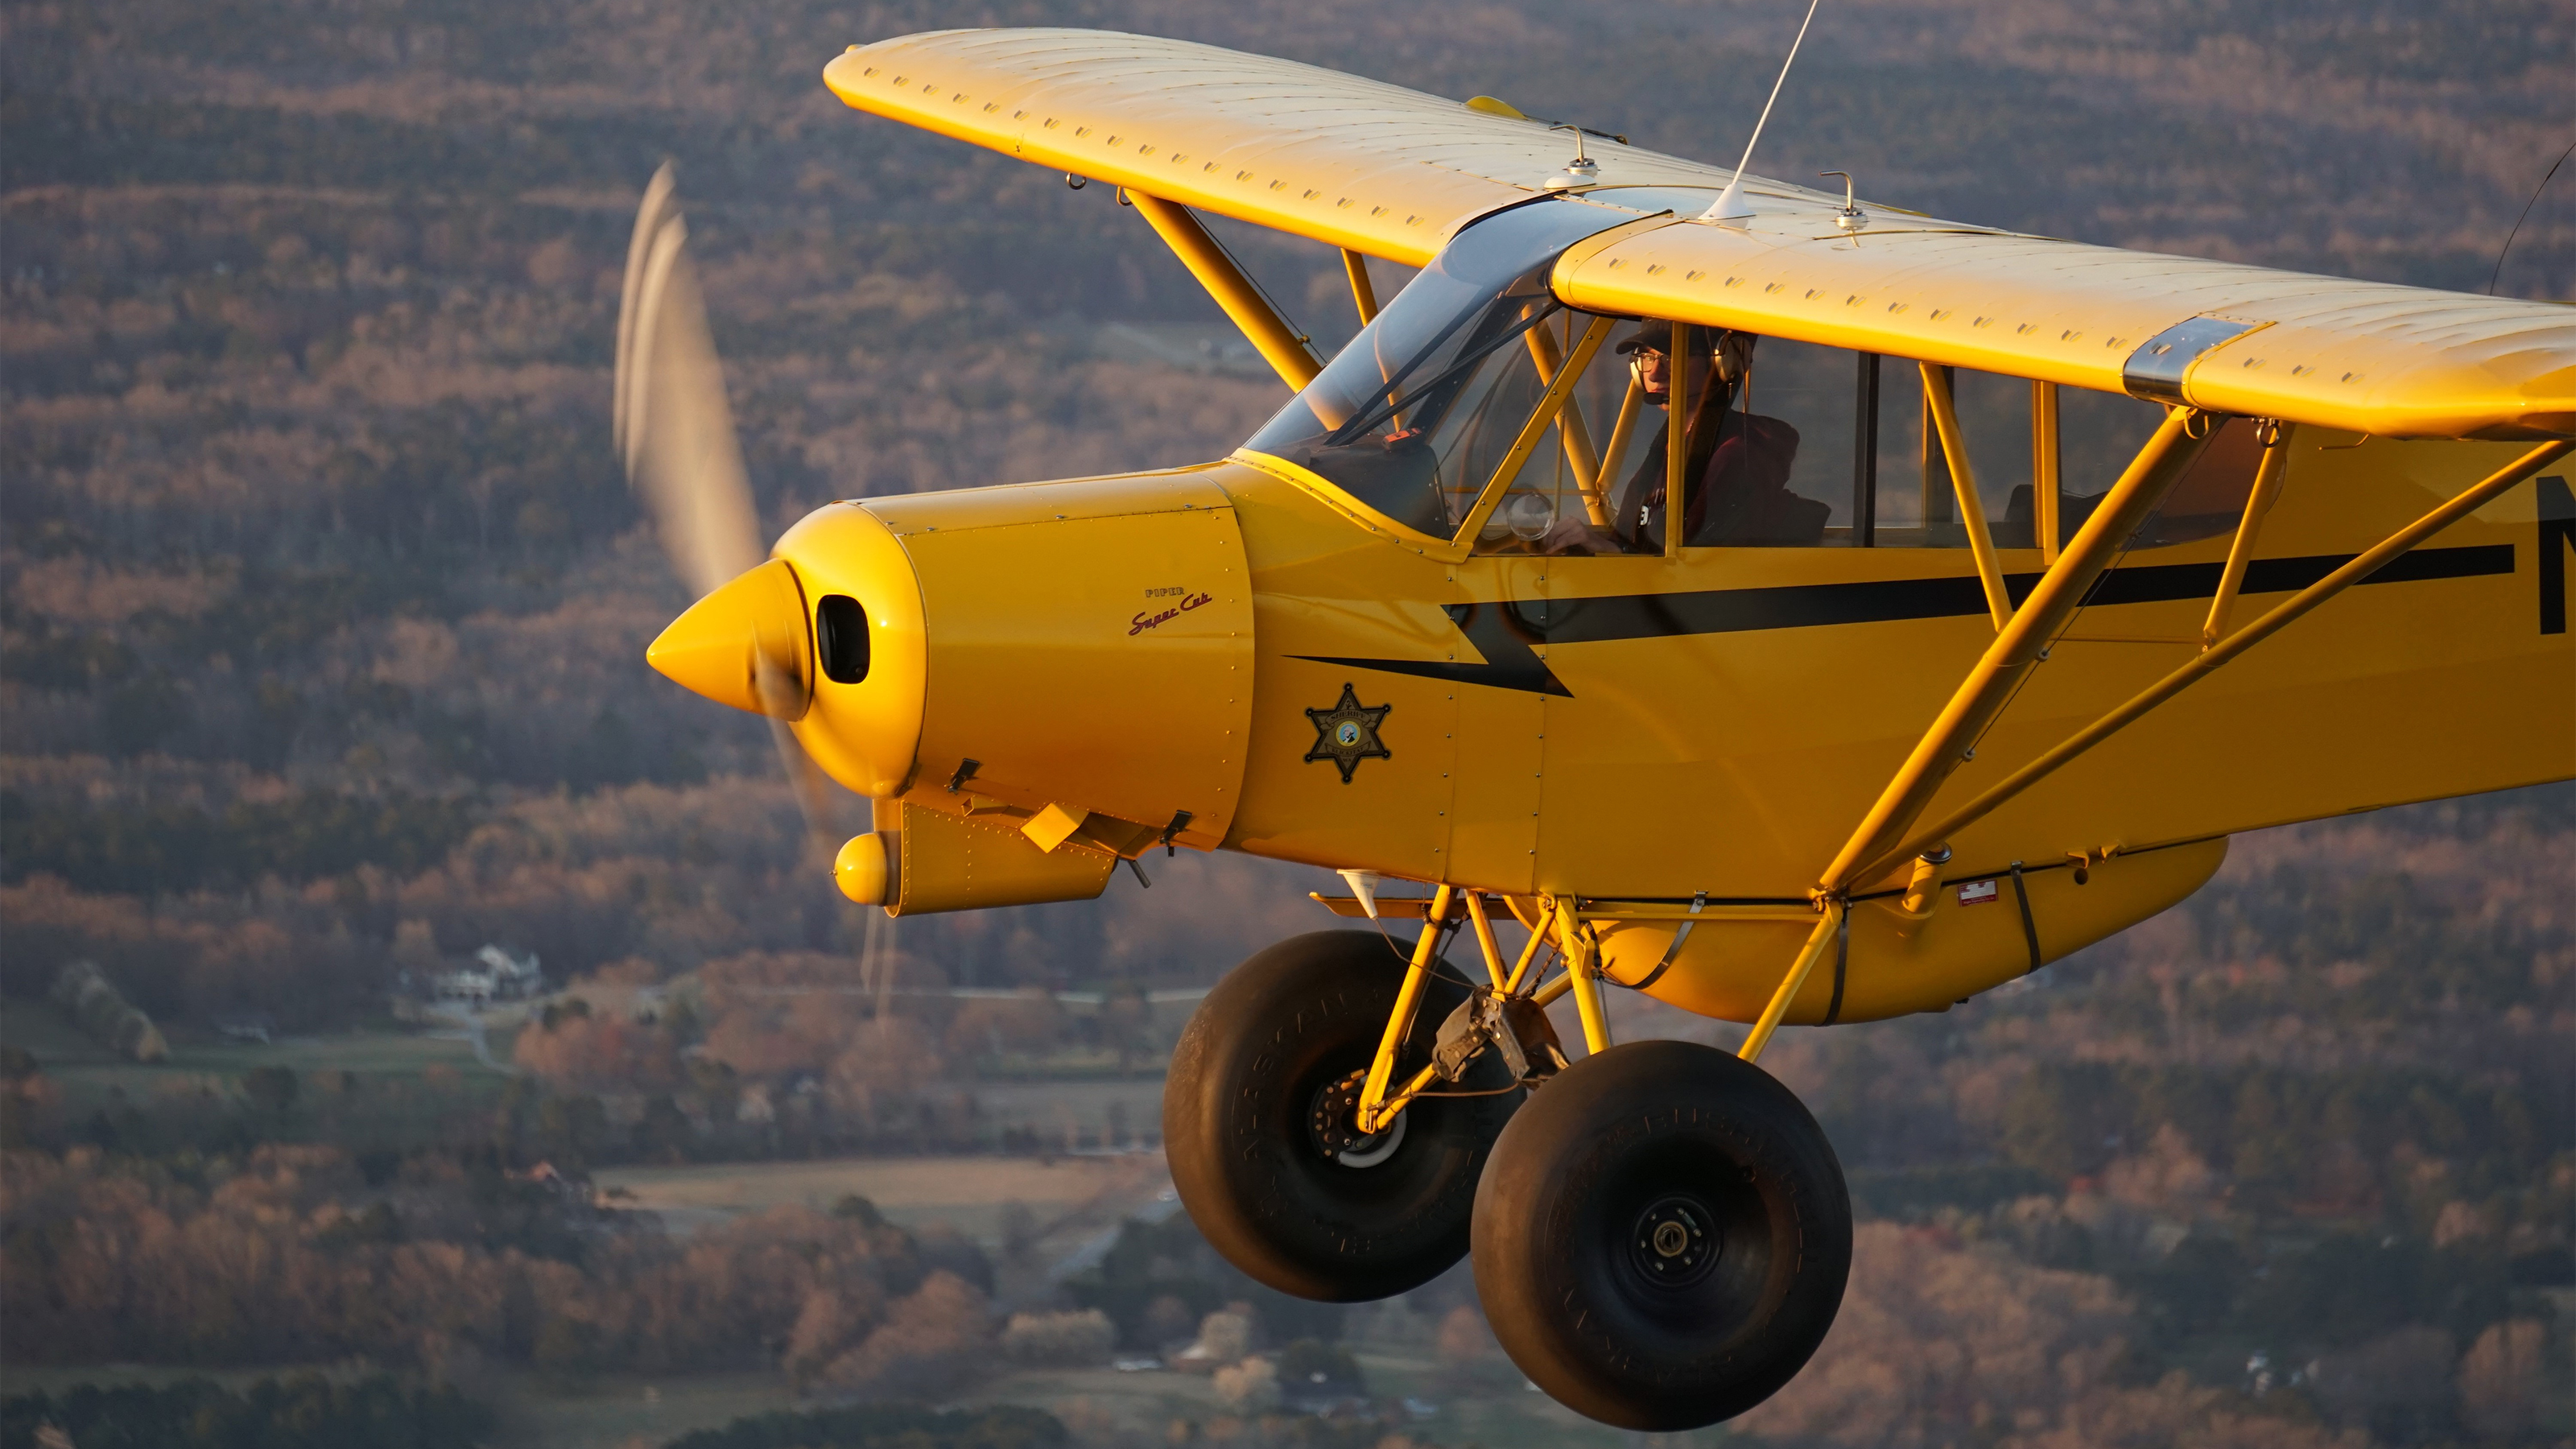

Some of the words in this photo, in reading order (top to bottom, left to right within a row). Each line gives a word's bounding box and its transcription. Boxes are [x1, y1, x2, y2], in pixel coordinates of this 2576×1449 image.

[1145, 586, 1185, 597] PIPER
[1128, 608, 1179, 636] Super
[1180, 592, 1213, 611] Cub
[1331, 711, 1365, 720] SHERIFF
